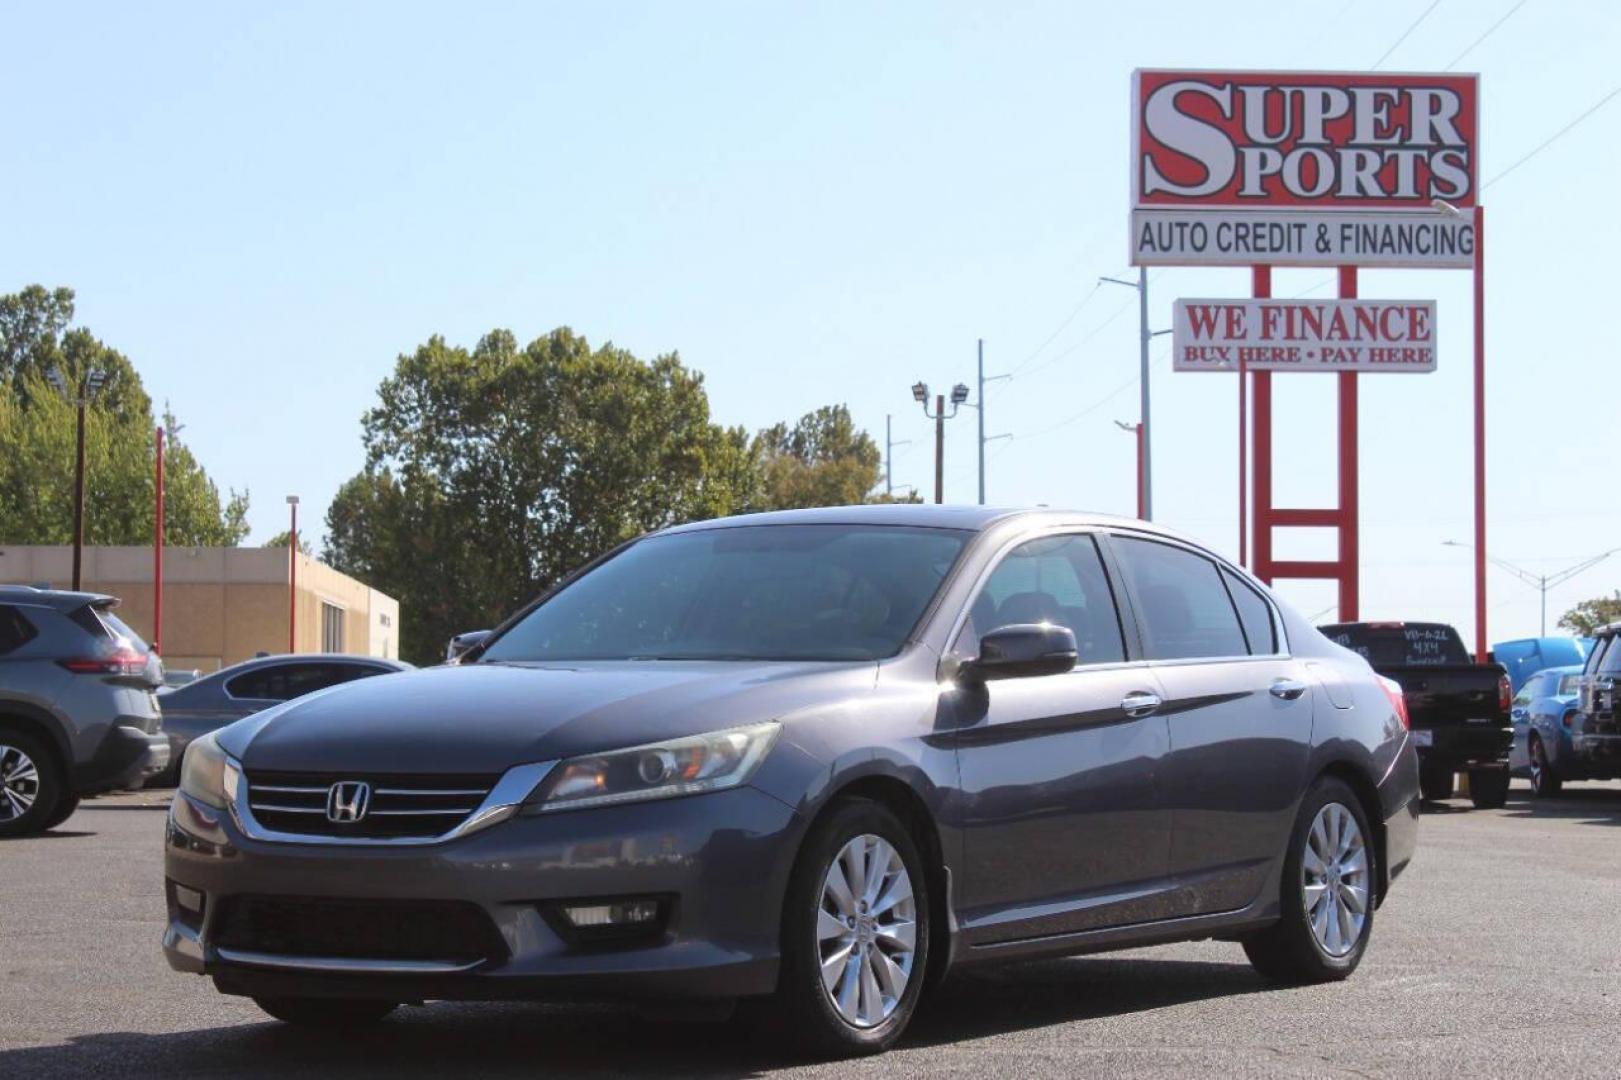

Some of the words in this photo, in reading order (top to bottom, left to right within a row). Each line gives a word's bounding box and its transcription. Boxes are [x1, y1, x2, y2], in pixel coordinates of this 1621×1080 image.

[1144, 80, 1467, 197] SUPER
[1139, 221, 1208, 252] AUTO
[1216, 222, 1307, 253] CREDIT
[1315, 223, 1331, 254] &
[1340, 223, 1474, 255] FINANCING
[1185, 304, 1248, 340] WE
[1258, 305, 1431, 342] FINANCE
[1184, 346, 1231, 362] BUY
[1321, 347, 1362, 363] PAY
[1369, 348, 1432, 364] HERE
